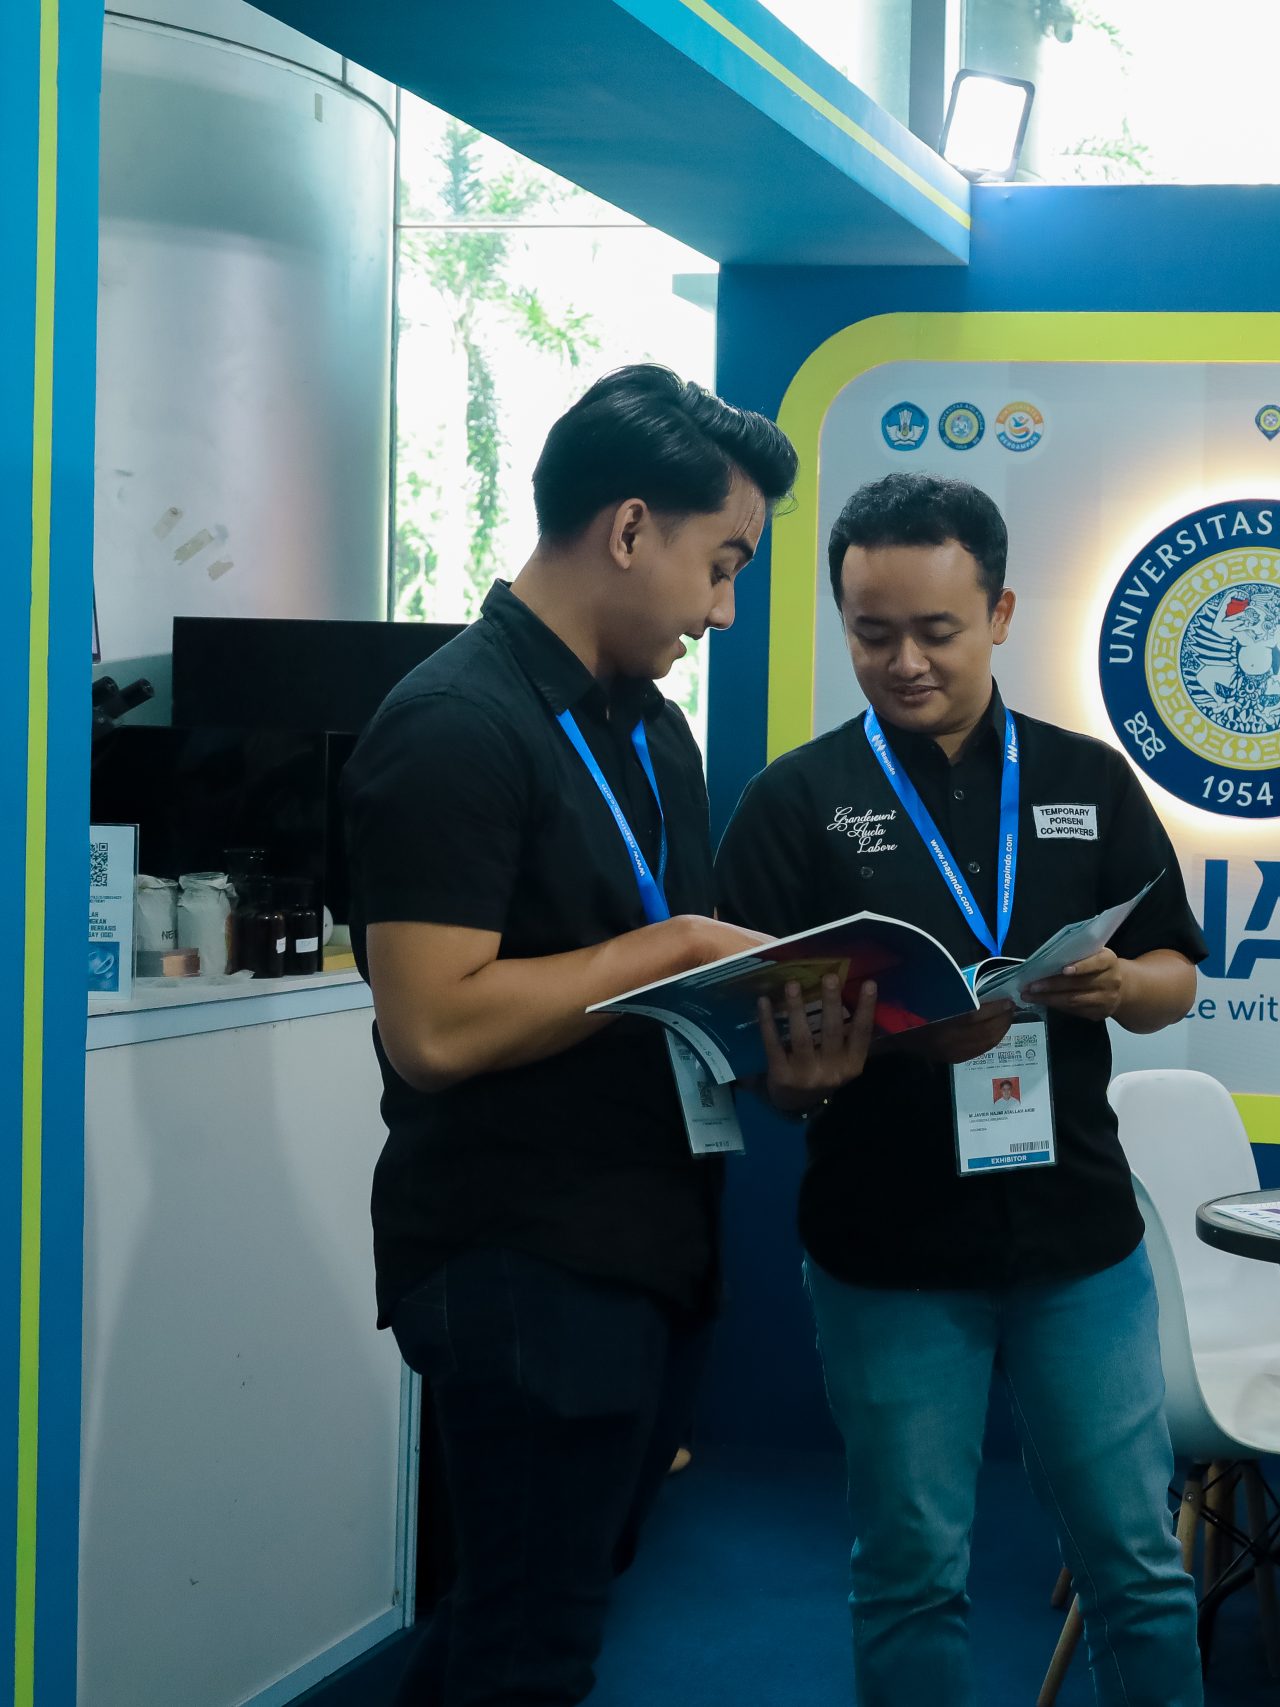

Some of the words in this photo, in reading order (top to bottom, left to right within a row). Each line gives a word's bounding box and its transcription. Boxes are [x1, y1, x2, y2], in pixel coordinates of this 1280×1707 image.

[1109, 510, 1274, 664] UNIVERSITAS
[1202, 775, 1274, 806] 1954
[1040, 808, 1090, 816] TEMPORARY
[847, 821, 887, 838] Aucta
[1050, 817, 1084, 826] PORSENI
[1040, 827, 1095, 837] CO-WORKERS
[857, 836, 898, 854] Labore
[929, 838, 974, 916] www.napindo.com
[1001, 833, 1014, 914] www.napindo.com
[991, 1155, 1027, 1165] EXHIBITOR
